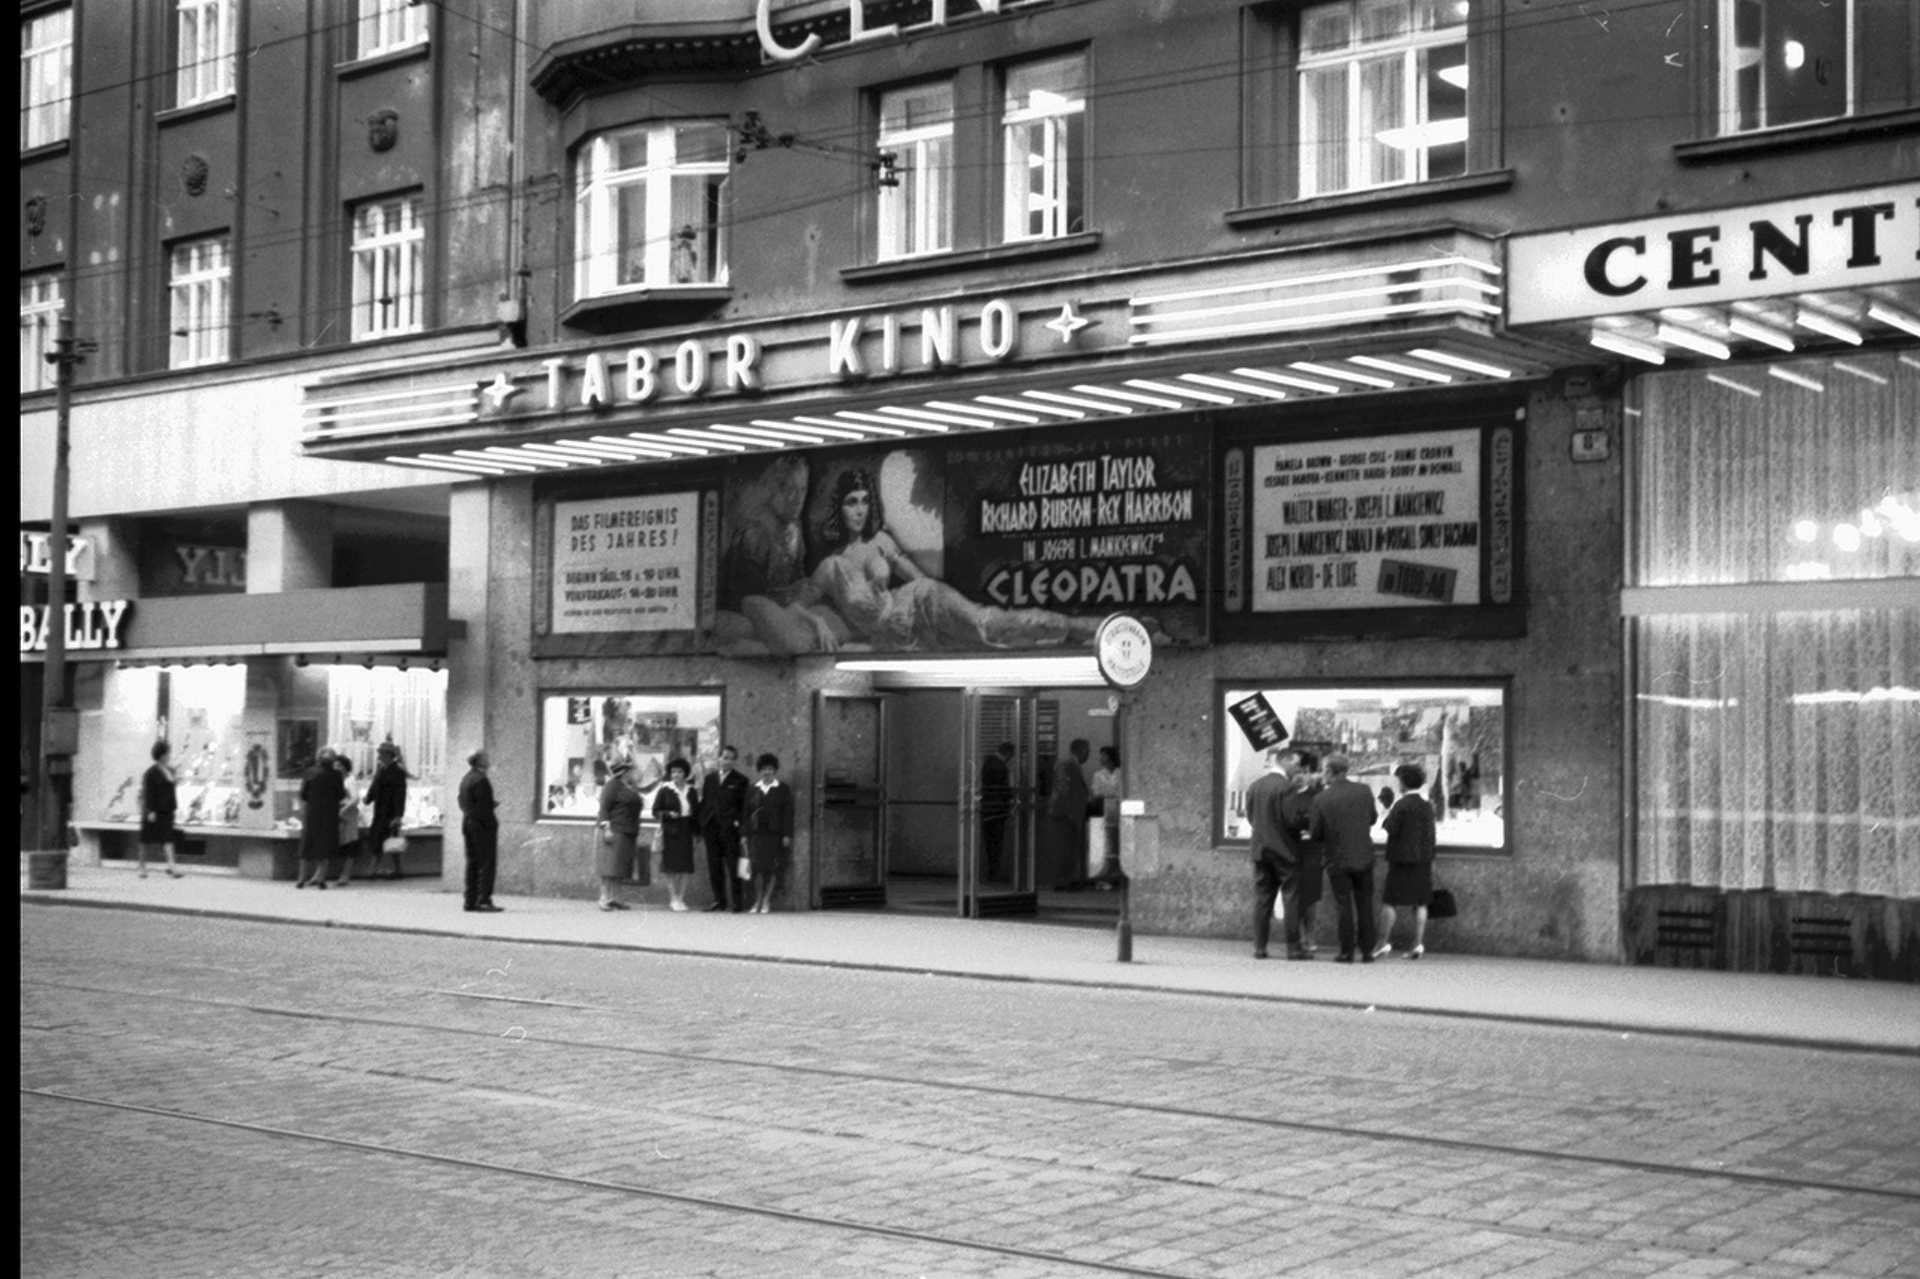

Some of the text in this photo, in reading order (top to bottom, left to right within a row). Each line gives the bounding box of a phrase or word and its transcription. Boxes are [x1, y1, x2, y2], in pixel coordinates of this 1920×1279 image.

[1584, 198, 1920, 297] CENT
[543, 299, 1021, 408] TABOR KINO
[1020, 455, 1157, 496] ELIZABETH TAYLOR
[571, 507, 679, 531] DAS FILMEREIGNIS
[981, 489, 1193, 533] RICHARD BURTON REX HARRISON
[571, 534, 596, 552] DES
[1040, 539, 1075, 562] JOSEPH
[986, 564, 1197, 605] CLEOPATRA
